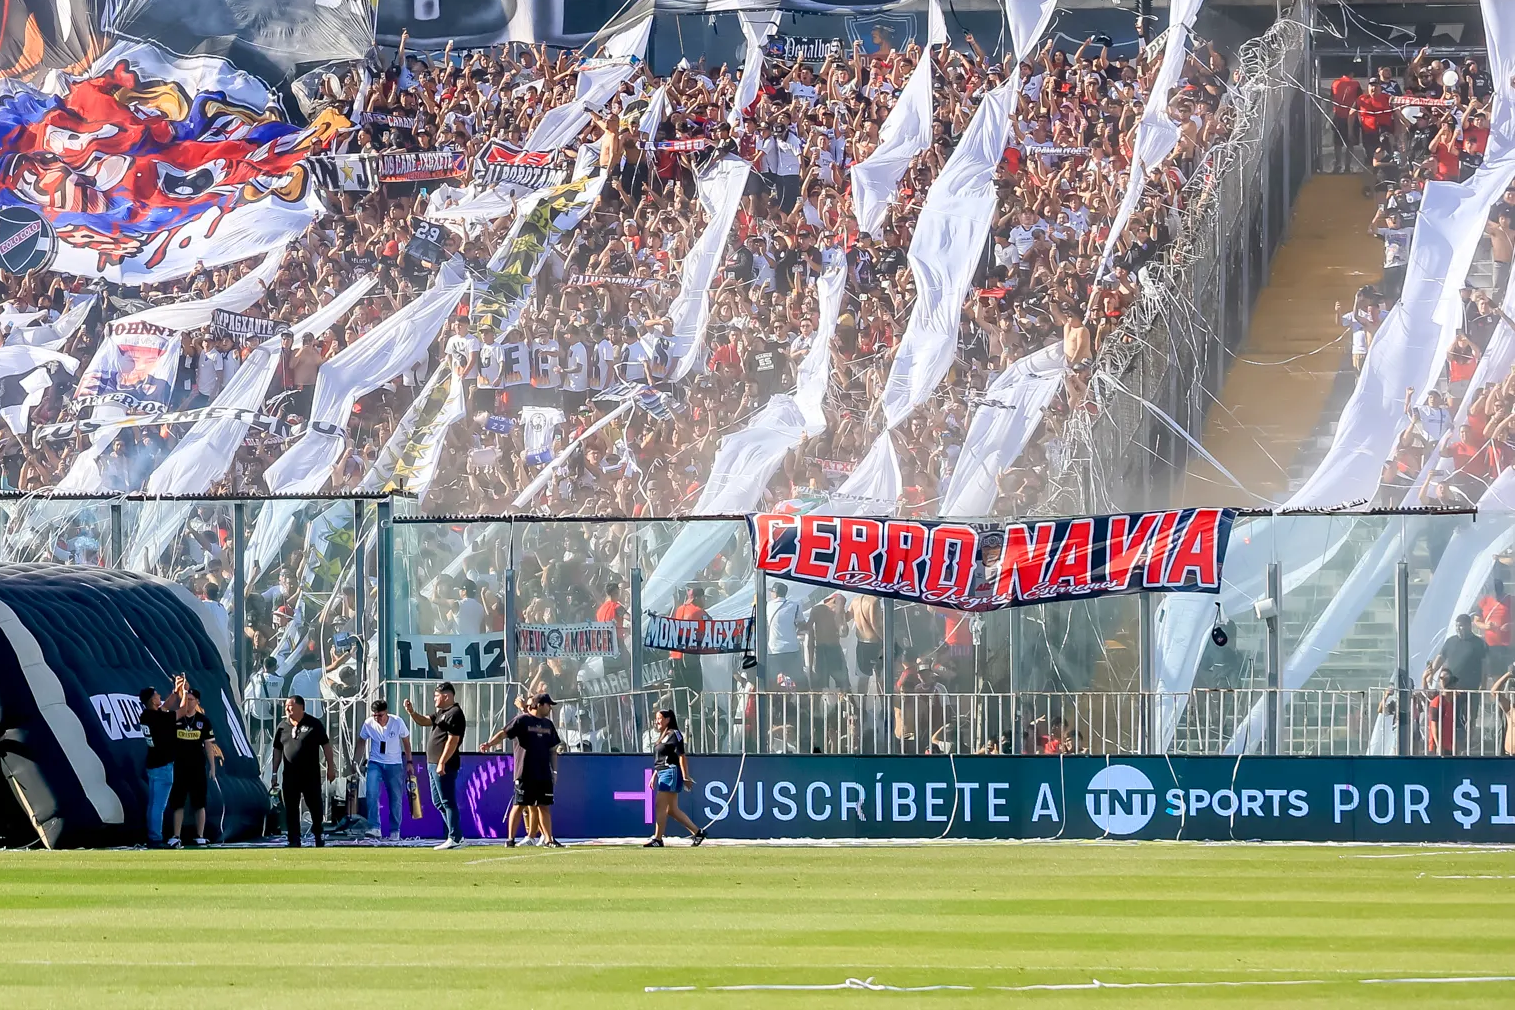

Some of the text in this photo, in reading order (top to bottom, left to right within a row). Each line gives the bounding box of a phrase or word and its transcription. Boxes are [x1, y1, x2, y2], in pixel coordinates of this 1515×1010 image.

[0, 222, 37, 251] COLO COLO
[416, 222, 439, 242] 29
[752, 508, 1223, 596] CERRO NAVIA
[564, 629, 614, 653] AMANECER
[646, 617, 699, 648] MONTE
[704, 772, 1010, 823] SUSCRÍBETE
[1032, 782, 1061, 823] A
[1166, 788, 1309, 818] SPORTS
[1333, 782, 1430, 824] POR
